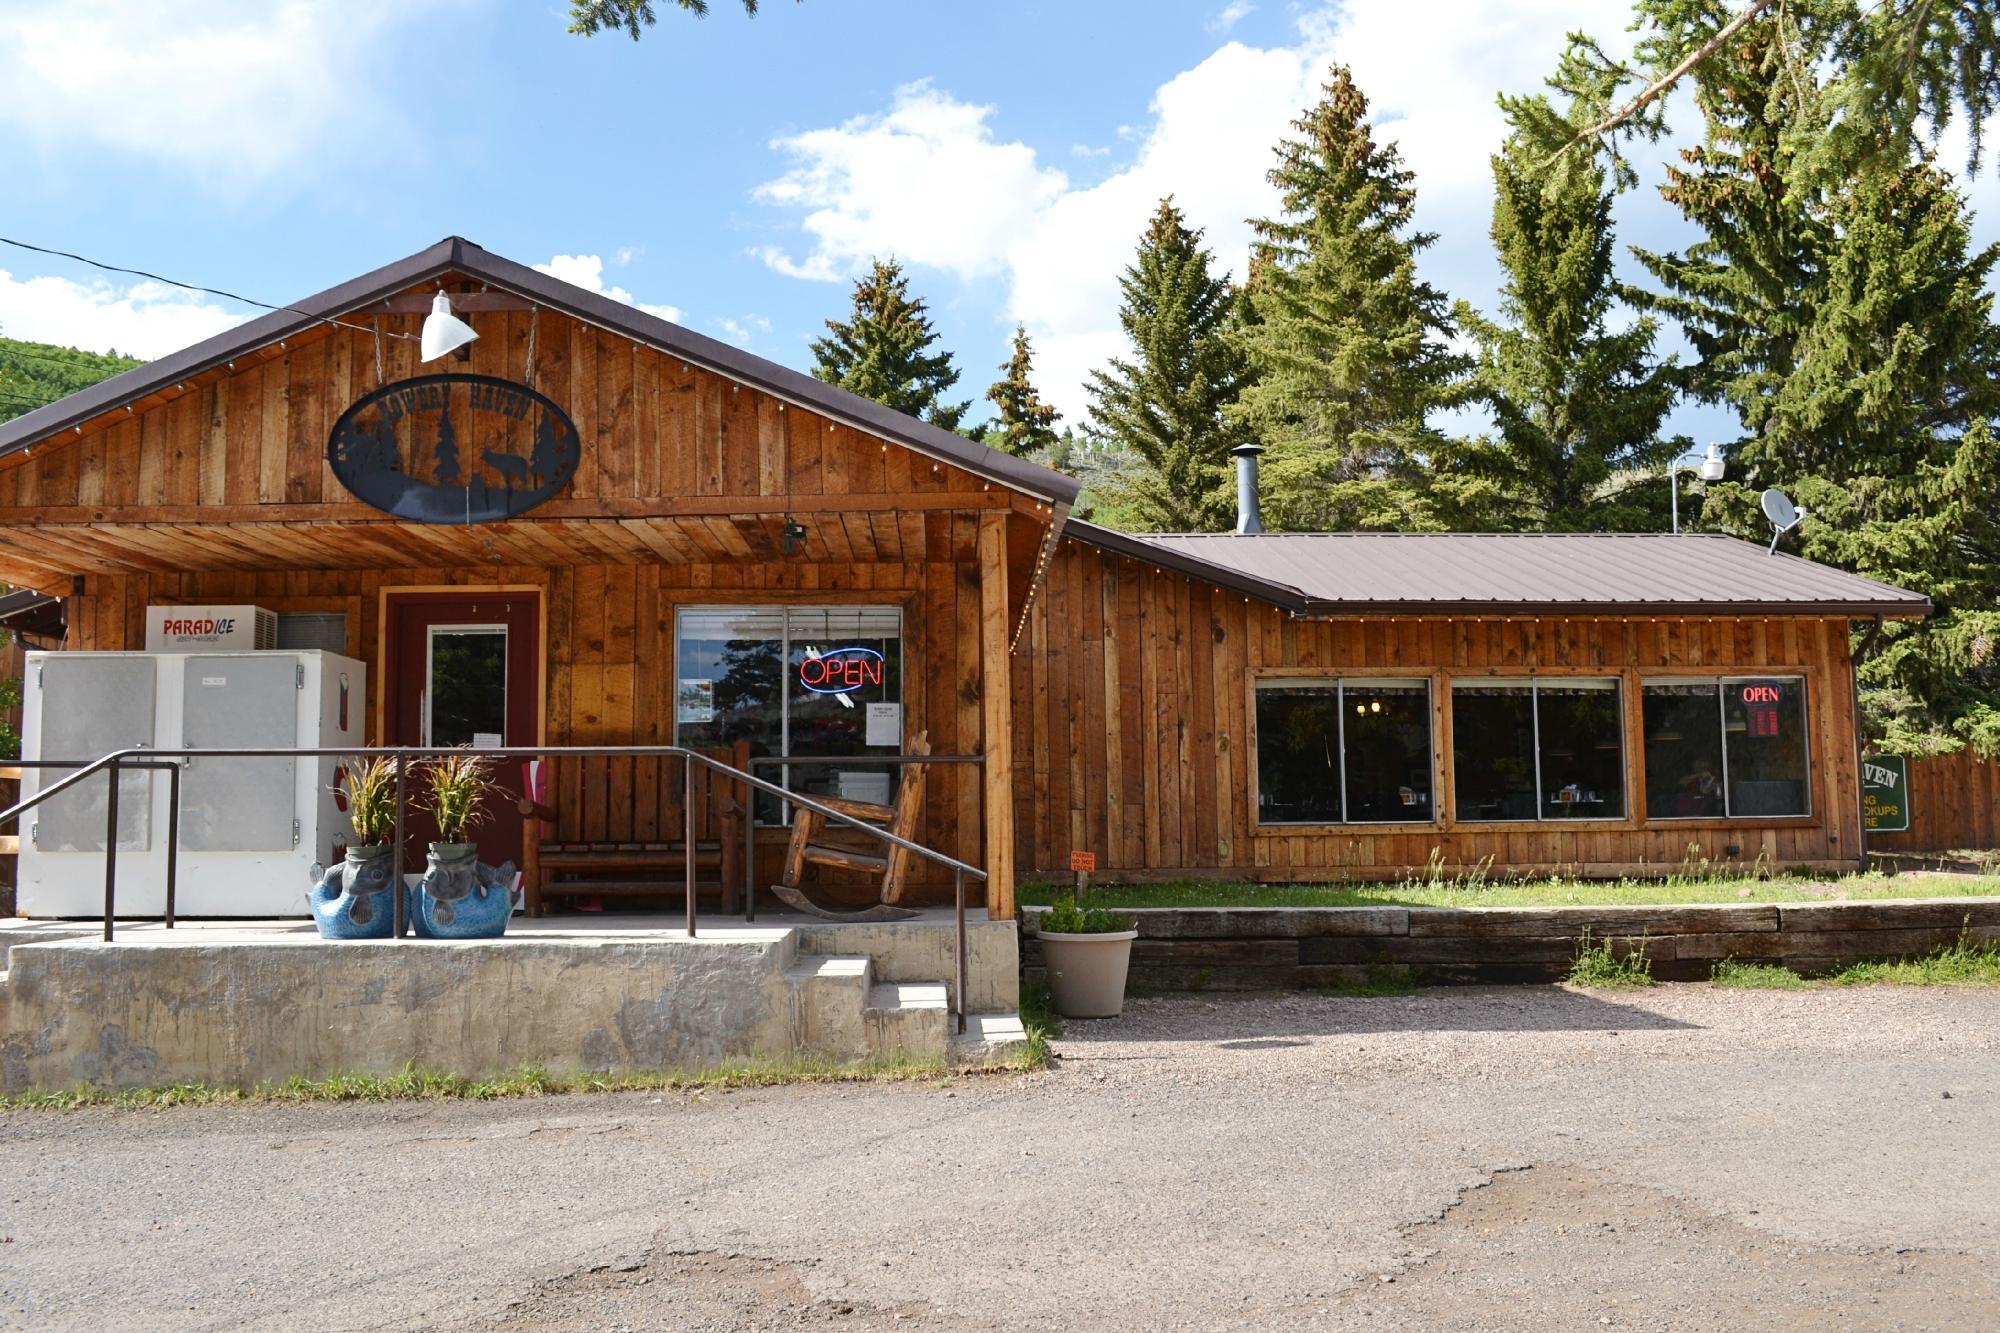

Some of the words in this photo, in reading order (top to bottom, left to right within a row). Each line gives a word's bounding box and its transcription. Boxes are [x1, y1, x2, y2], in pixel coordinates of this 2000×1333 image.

[469, 382, 529, 421] HAVEN
[163, 618, 236, 636] PARADICE
[801, 658, 882, 685] OPEN
[1743, 687, 1779, 702] OPEN
[1863, 763, 1899, 788] VEN
